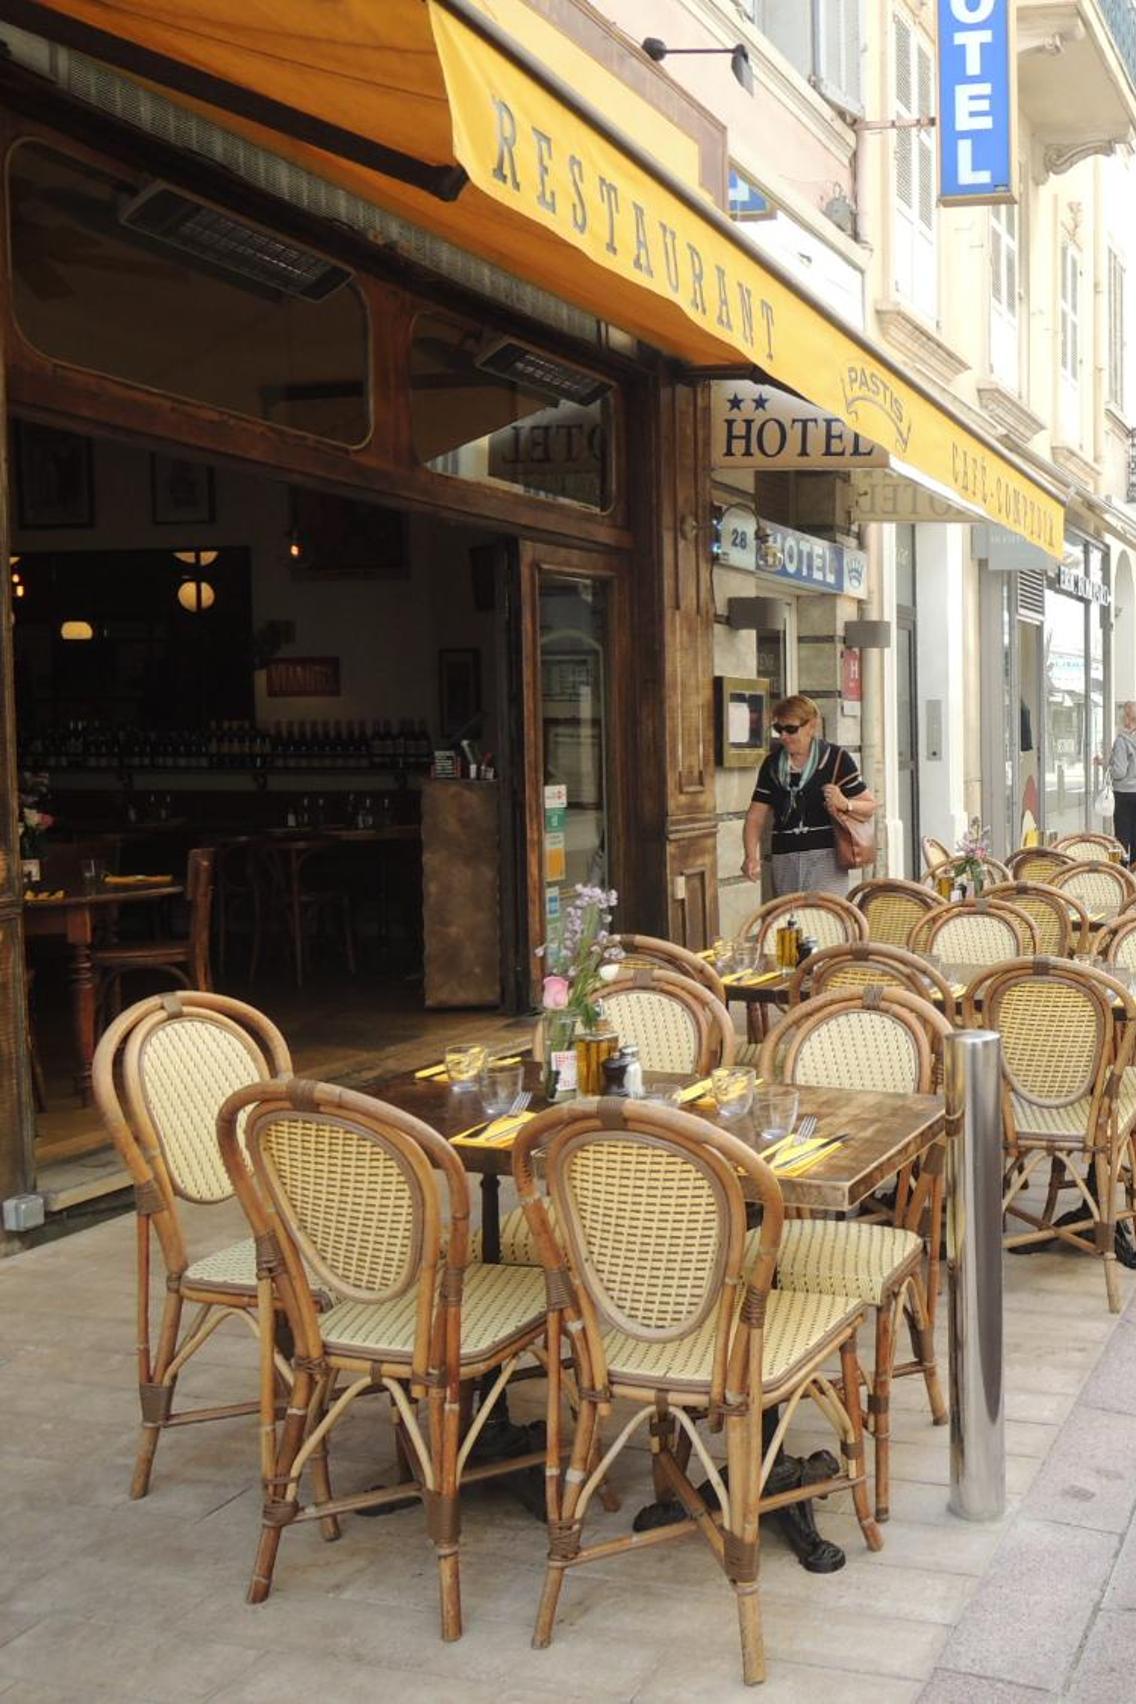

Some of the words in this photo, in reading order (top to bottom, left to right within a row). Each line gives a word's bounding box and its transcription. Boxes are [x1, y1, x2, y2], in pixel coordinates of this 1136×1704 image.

[491, 93, 775, 361] RESTAURANT
[847, 366, 904, 423] PASTIS
[722, 417, 875, 458] HOTEL
[731, 527, 747, 550] 28
